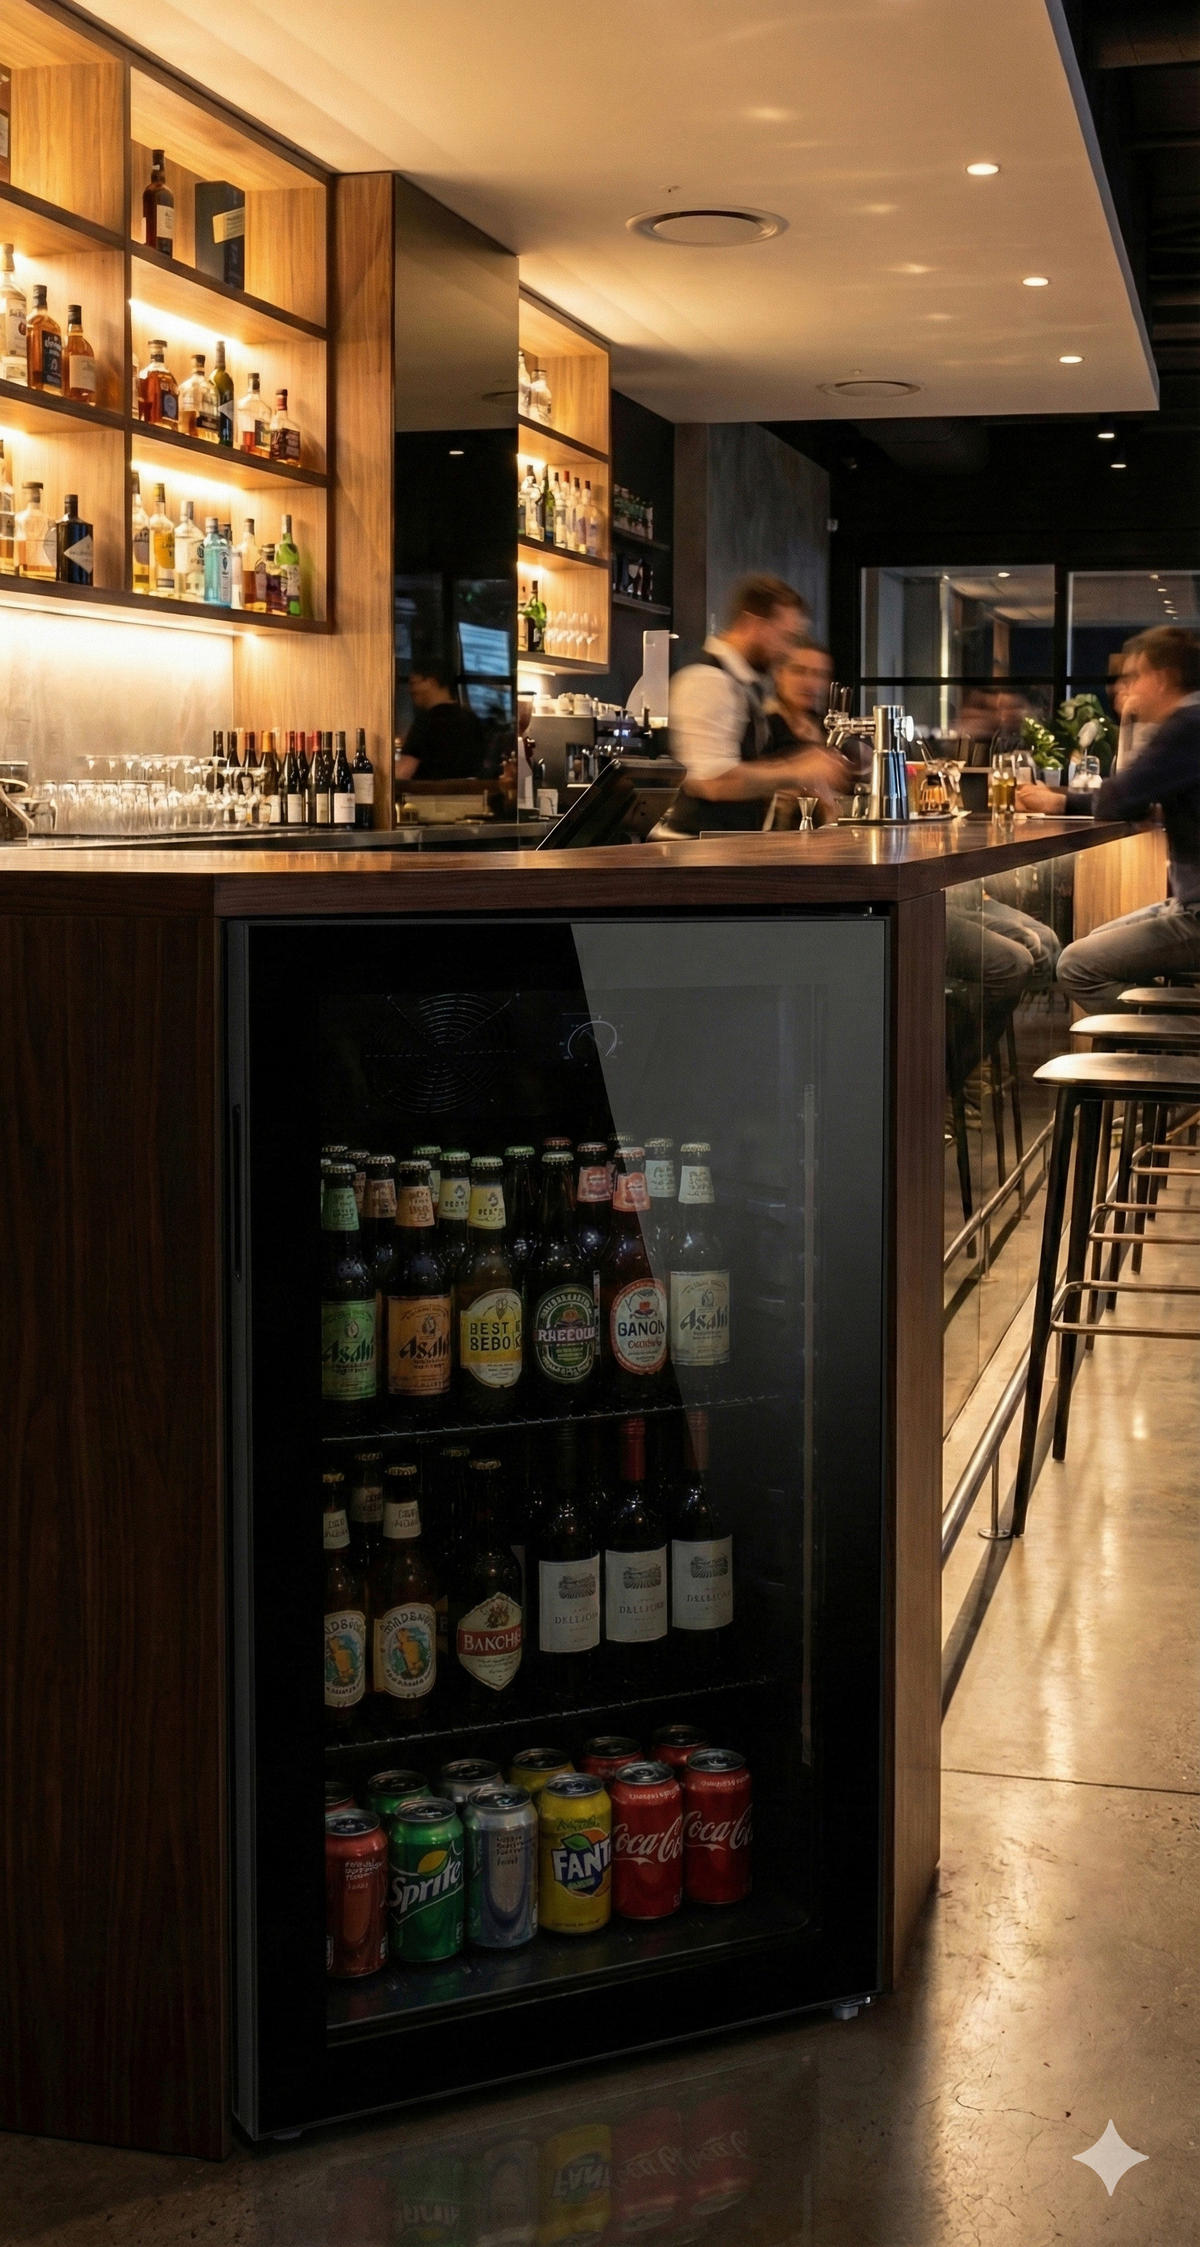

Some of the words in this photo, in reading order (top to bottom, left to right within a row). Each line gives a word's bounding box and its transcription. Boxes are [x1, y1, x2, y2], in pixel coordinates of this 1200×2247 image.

[470, 1321, 510, 1335] BEST
[679, 1304, 729, 1331] Asahi
[388, 1856, 464, 1914] Sprite
